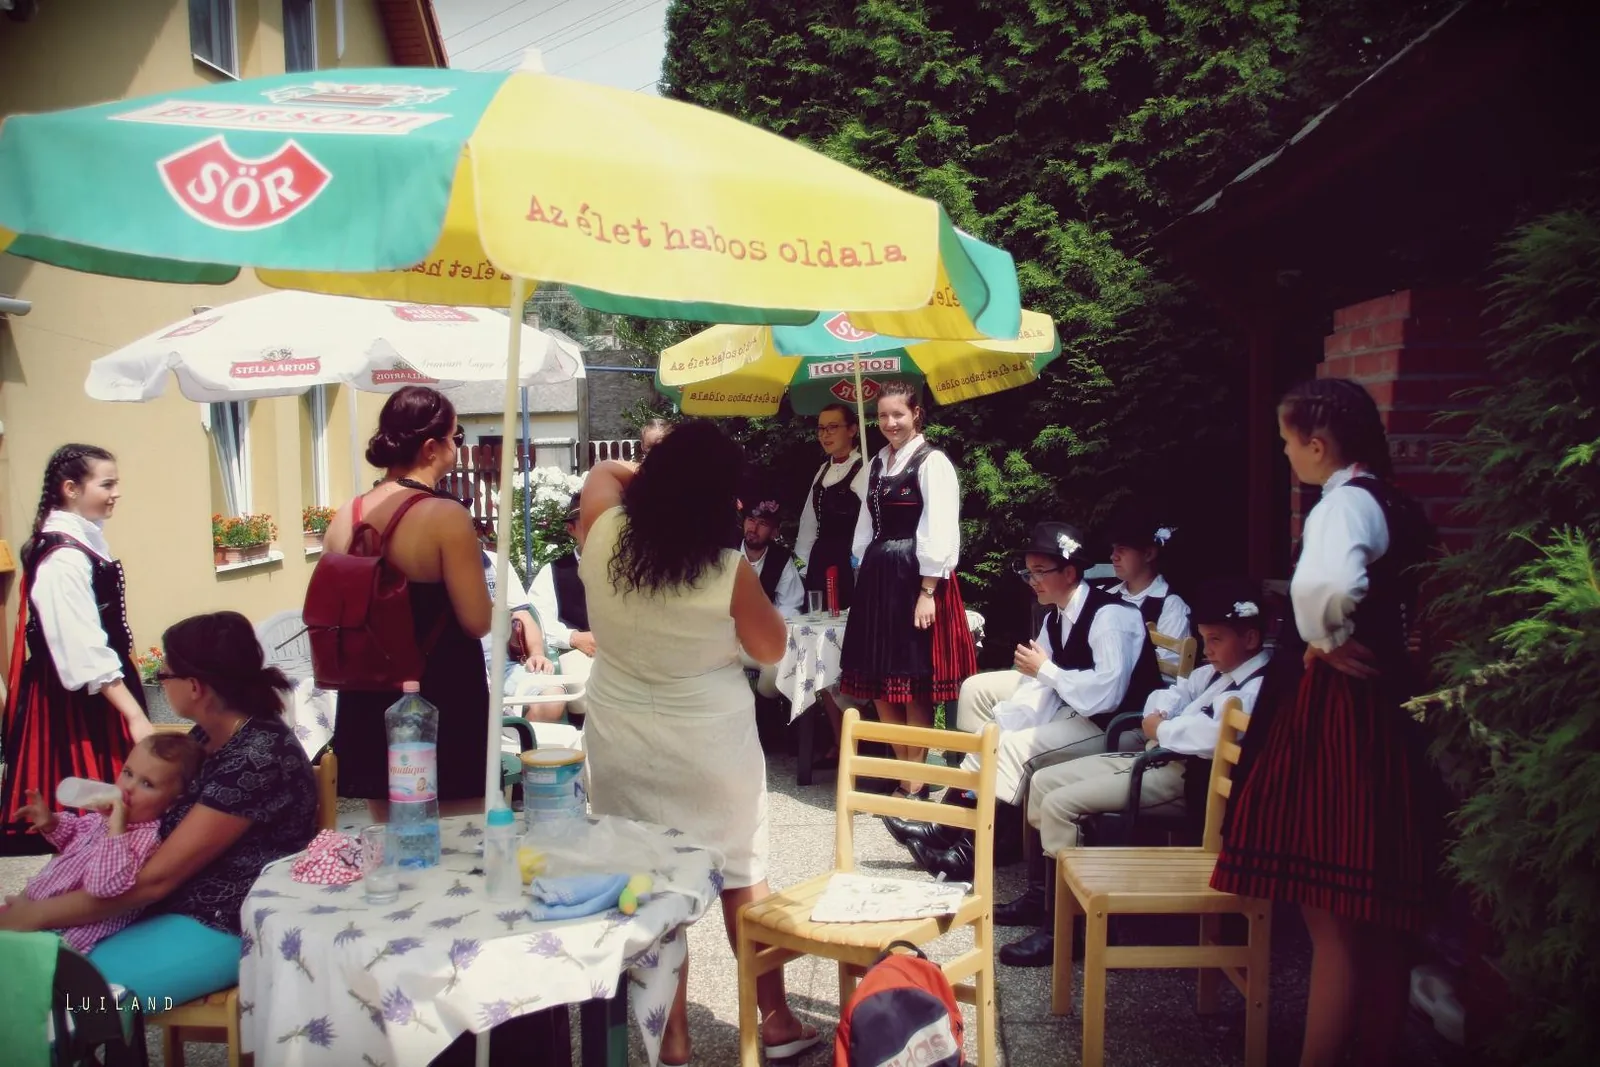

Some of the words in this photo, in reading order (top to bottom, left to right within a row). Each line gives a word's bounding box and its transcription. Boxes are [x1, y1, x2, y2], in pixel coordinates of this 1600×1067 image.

[155, 106, 419, 129] BORSODI
[187, 161, 302, 219] SÖR
[525, 194, 569, 229] Az
[576, 202, 652, 248] élet
[660, 220, 767, 262] habos
[778, 238, 907, 272] oldala
[235, 365, 276, 375] STELLA
[276, 362, 316, 373] ARTOIS
